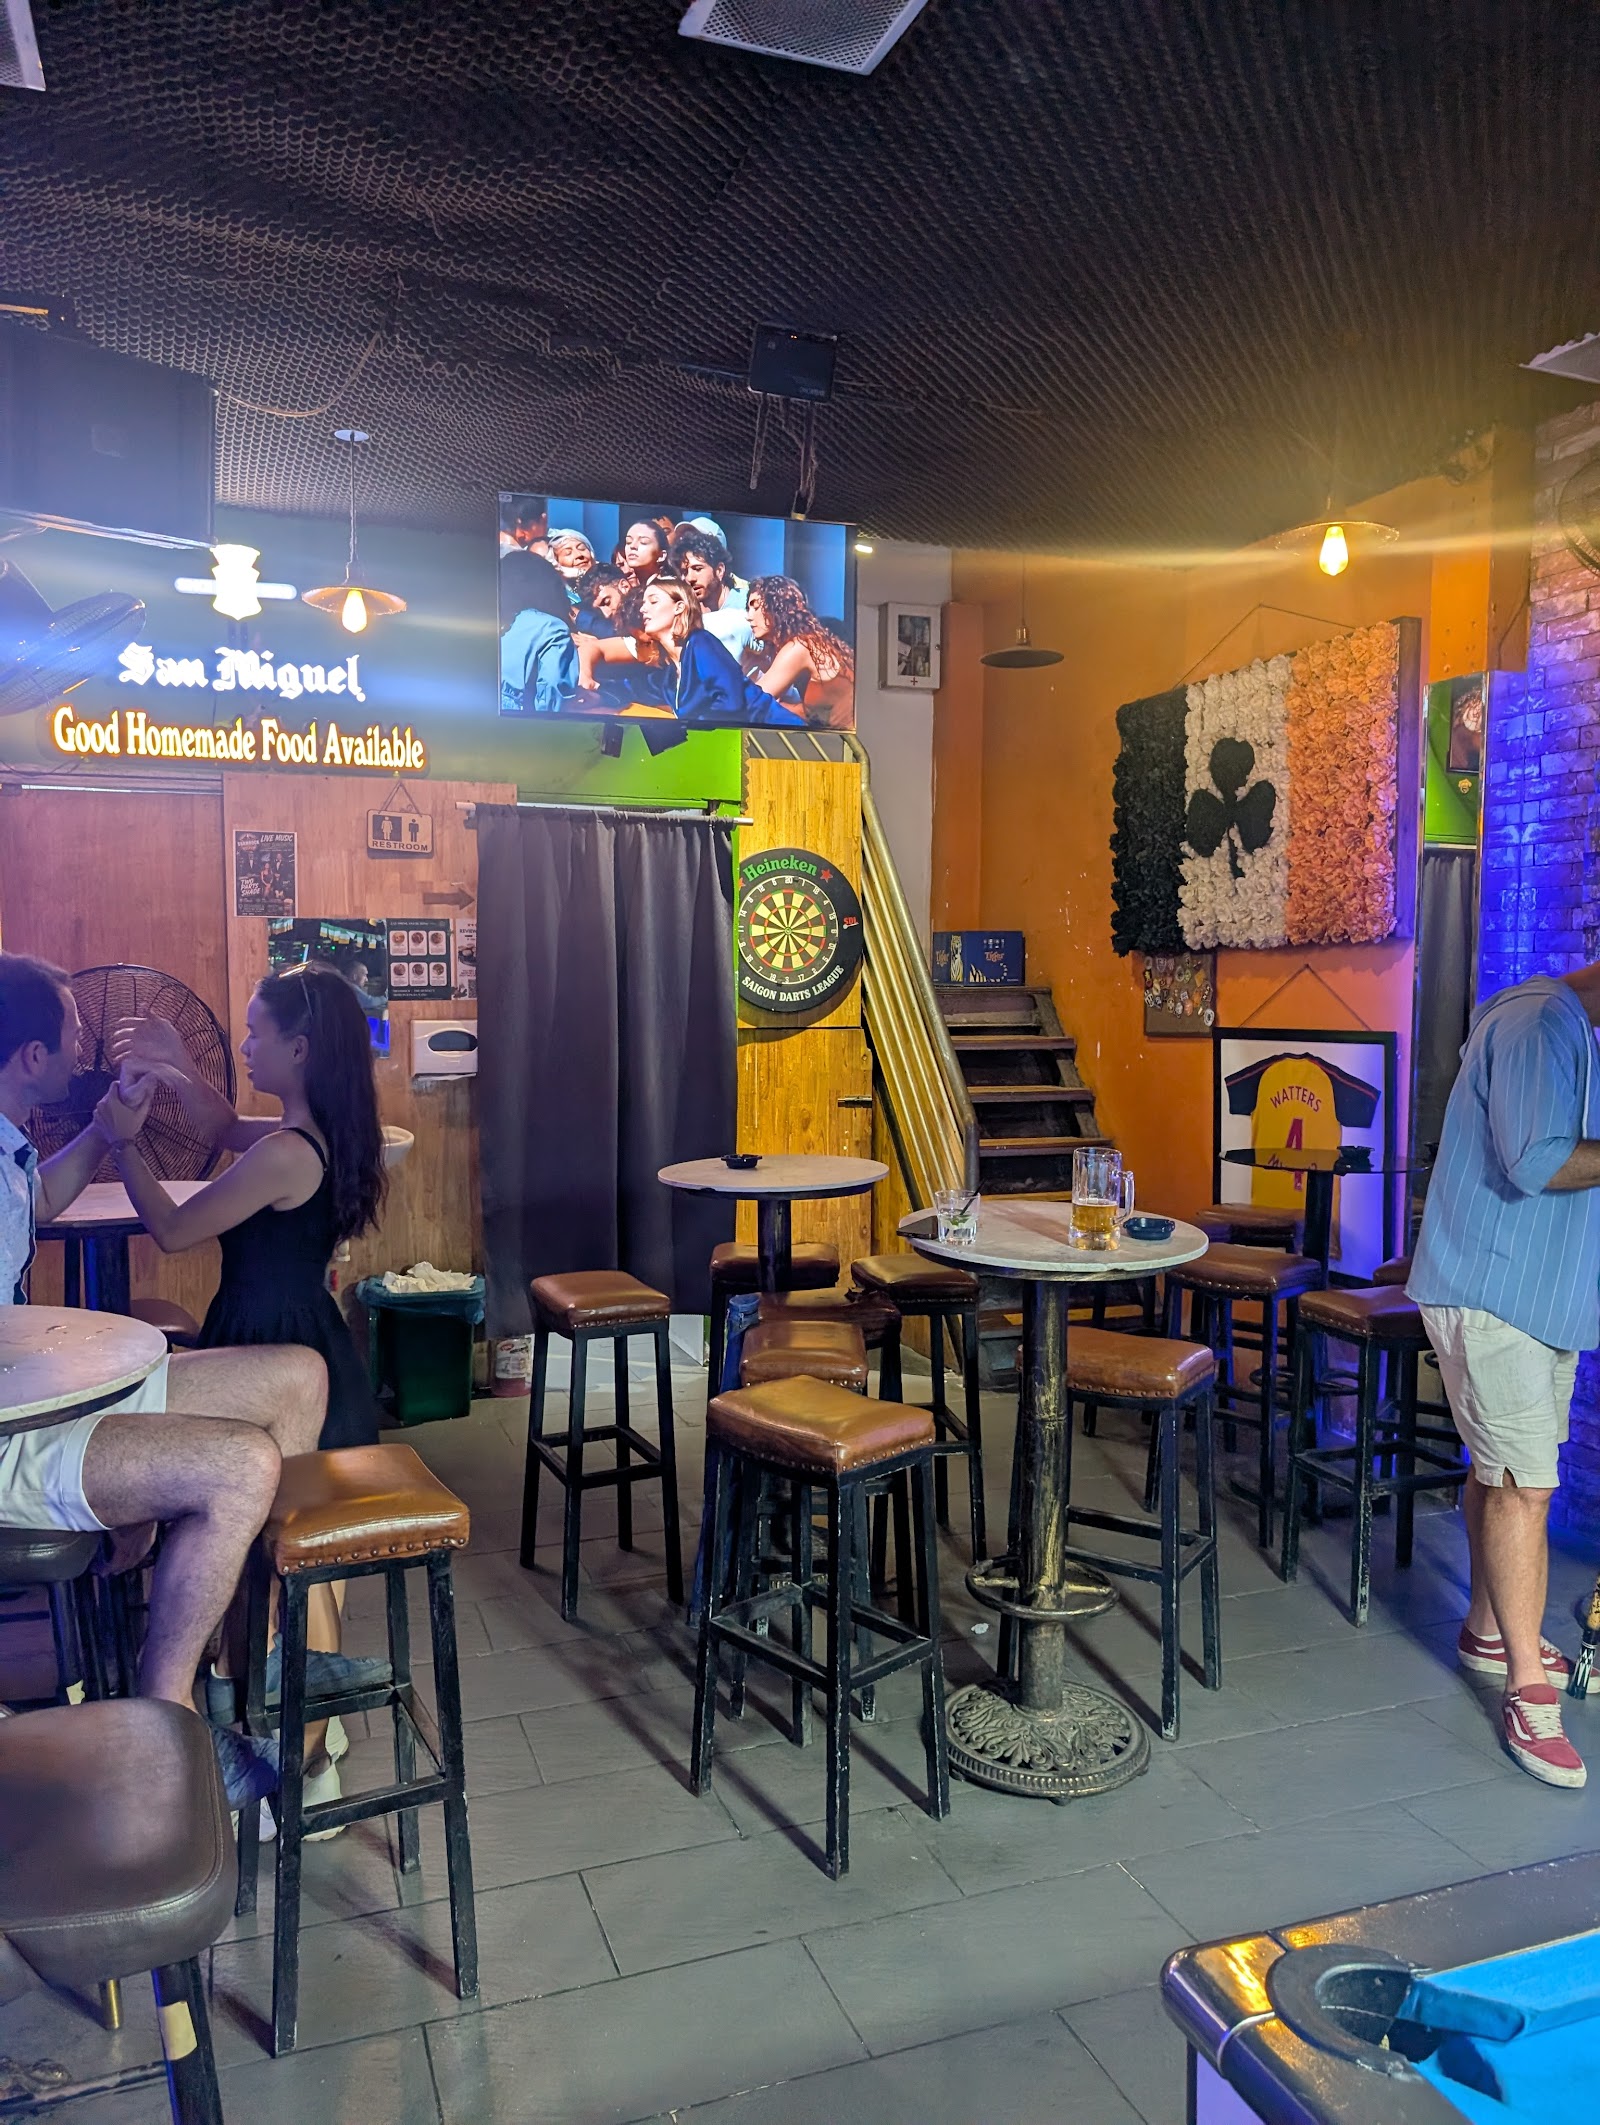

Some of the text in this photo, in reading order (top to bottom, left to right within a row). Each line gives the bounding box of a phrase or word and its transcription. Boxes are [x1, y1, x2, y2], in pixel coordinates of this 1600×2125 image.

[118, 642, 362, 700] San Miguel
[53, 706, 424, 769] Good Homemade Food Available
[260, 834, 293, 843] LIVE MUSIC
[372, 841, 428, 851] RESTROOM
[742, 854, 818, 882] Heineken
[984, 951, 1005, 963] Tiger
[741, 965, 845, 1002] SAIGON DARTS LEAGUE
[1270, 1085, 1322, 1112] WATTERS
